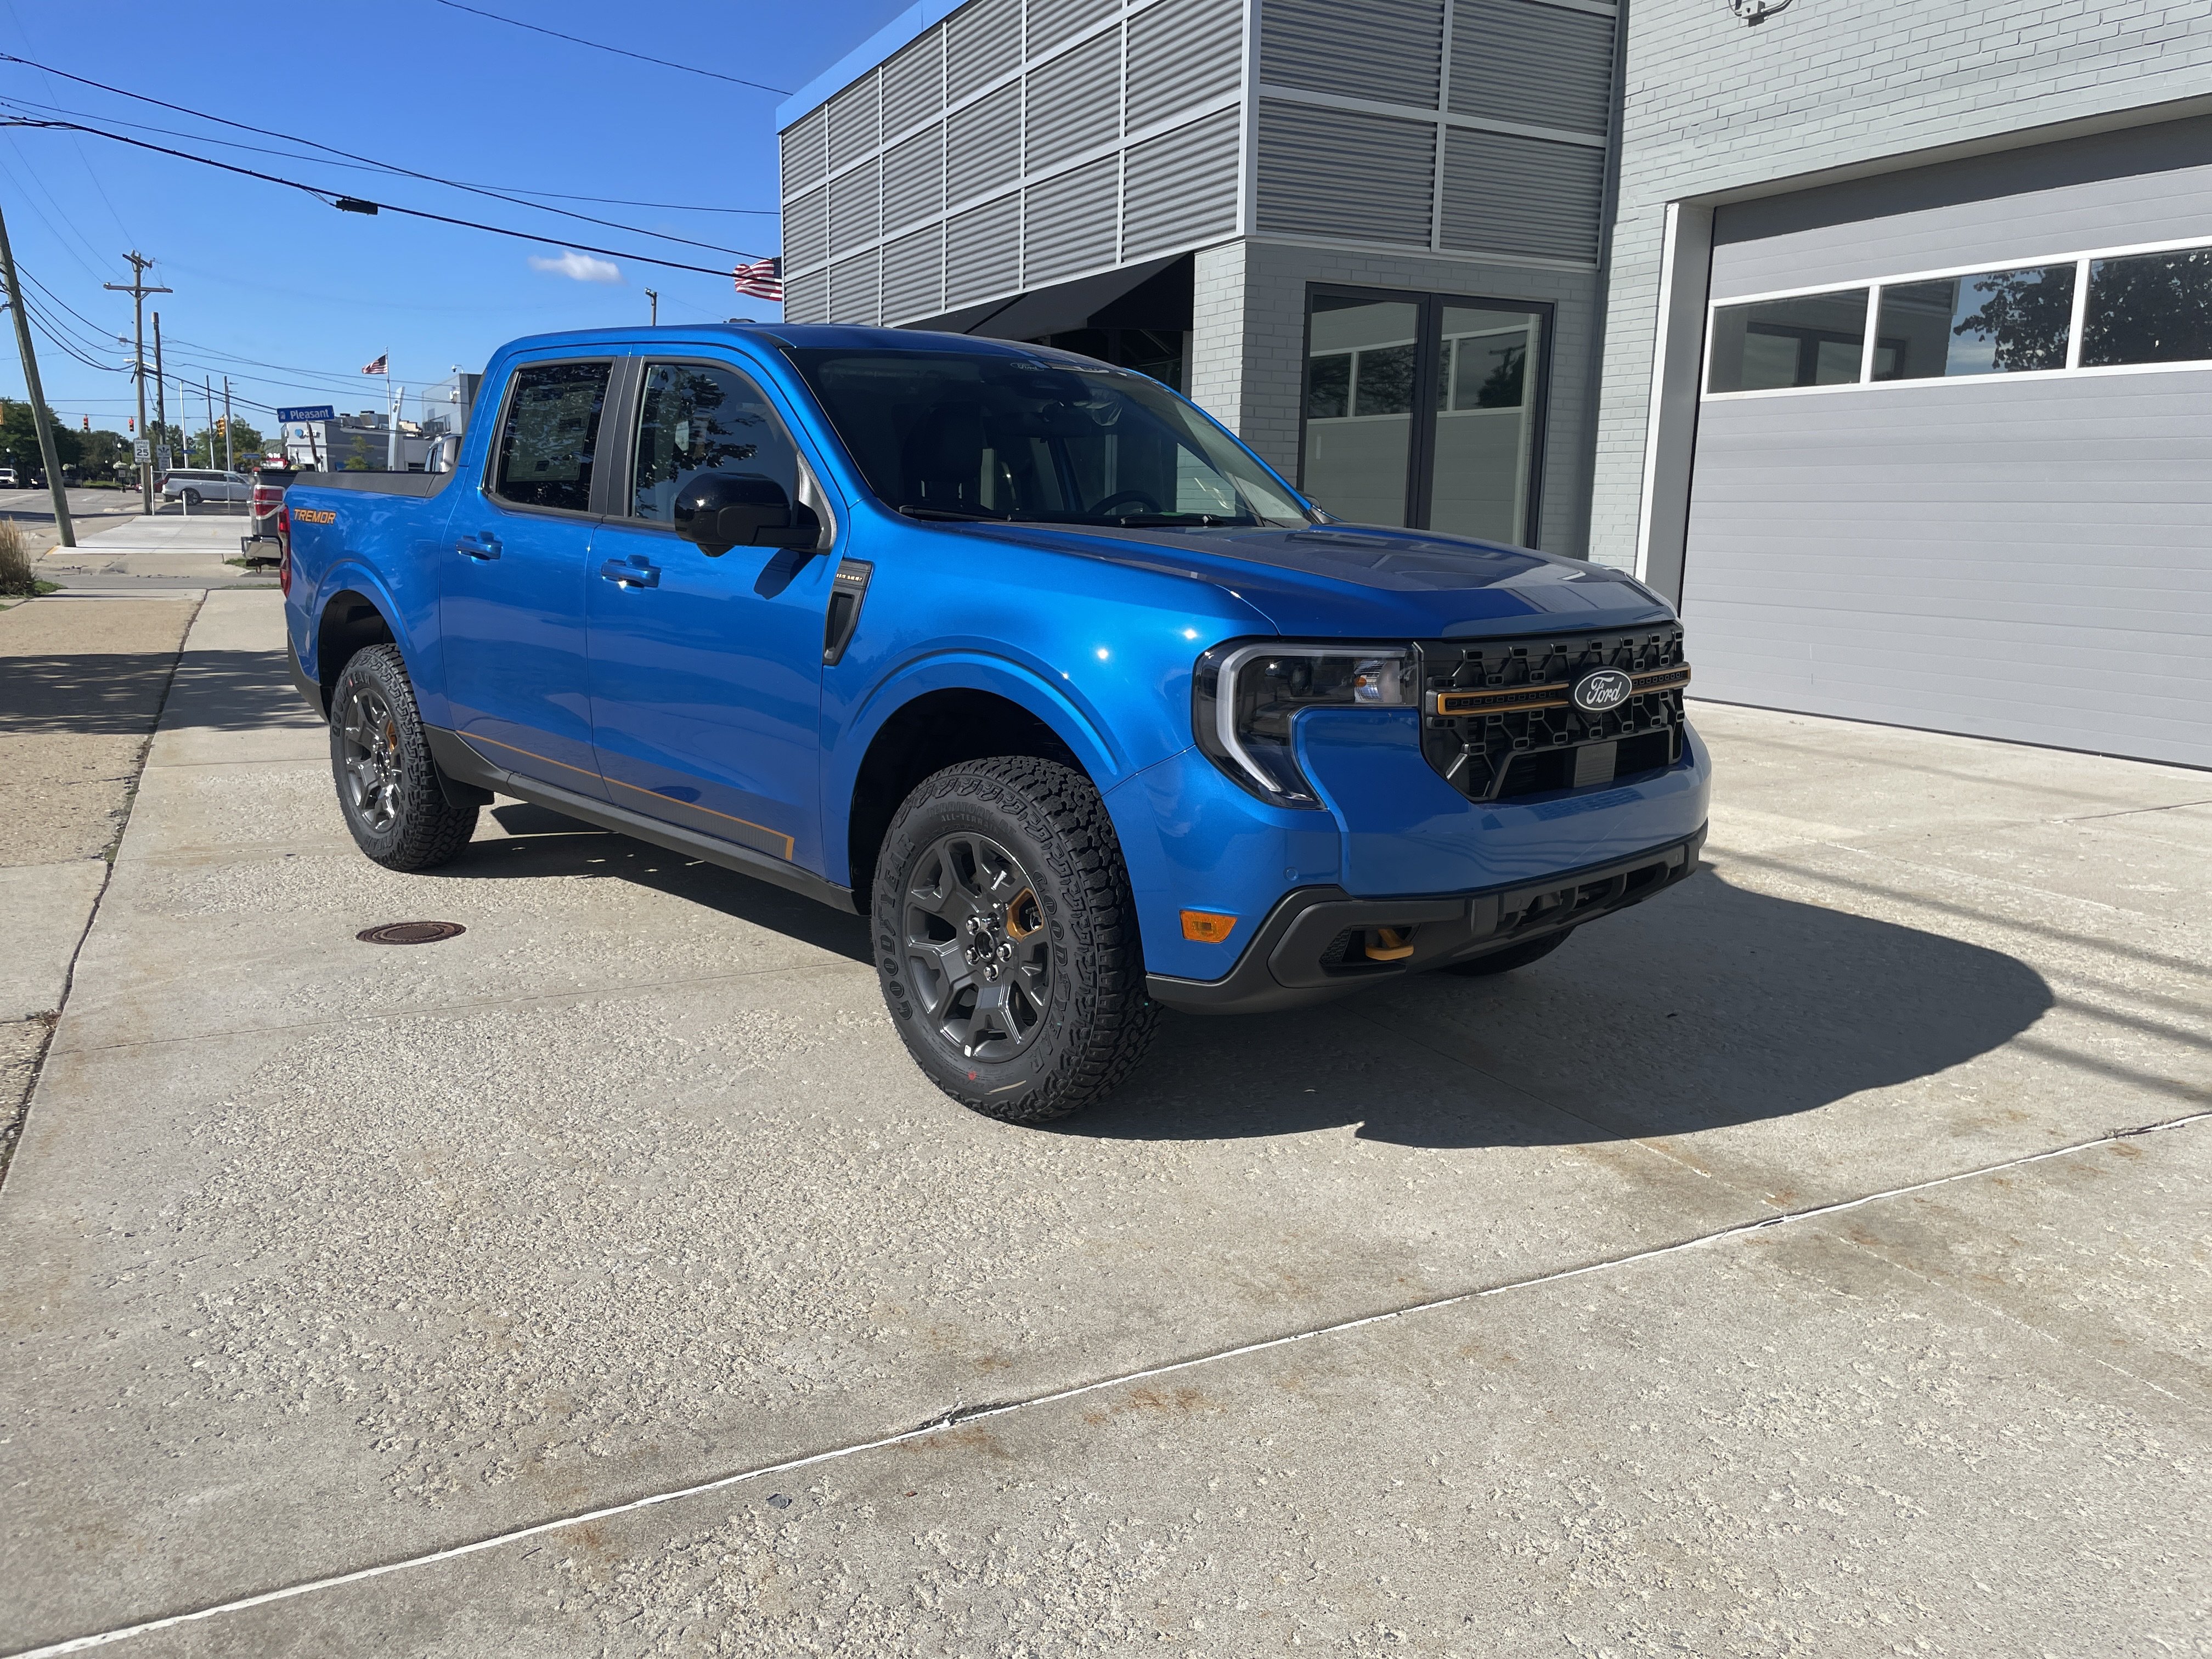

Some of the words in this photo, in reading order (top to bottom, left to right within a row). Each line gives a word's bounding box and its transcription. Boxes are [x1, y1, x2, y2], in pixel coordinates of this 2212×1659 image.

[290, 409, 330, 420] Pleasant
[294, 508, 336, 524] TREMOR
[1586, 676, 1622, 704] Ford
[927, 801, 994, 820] TERRITORY
[878, 833, 915, 1020] GOODYEAR
